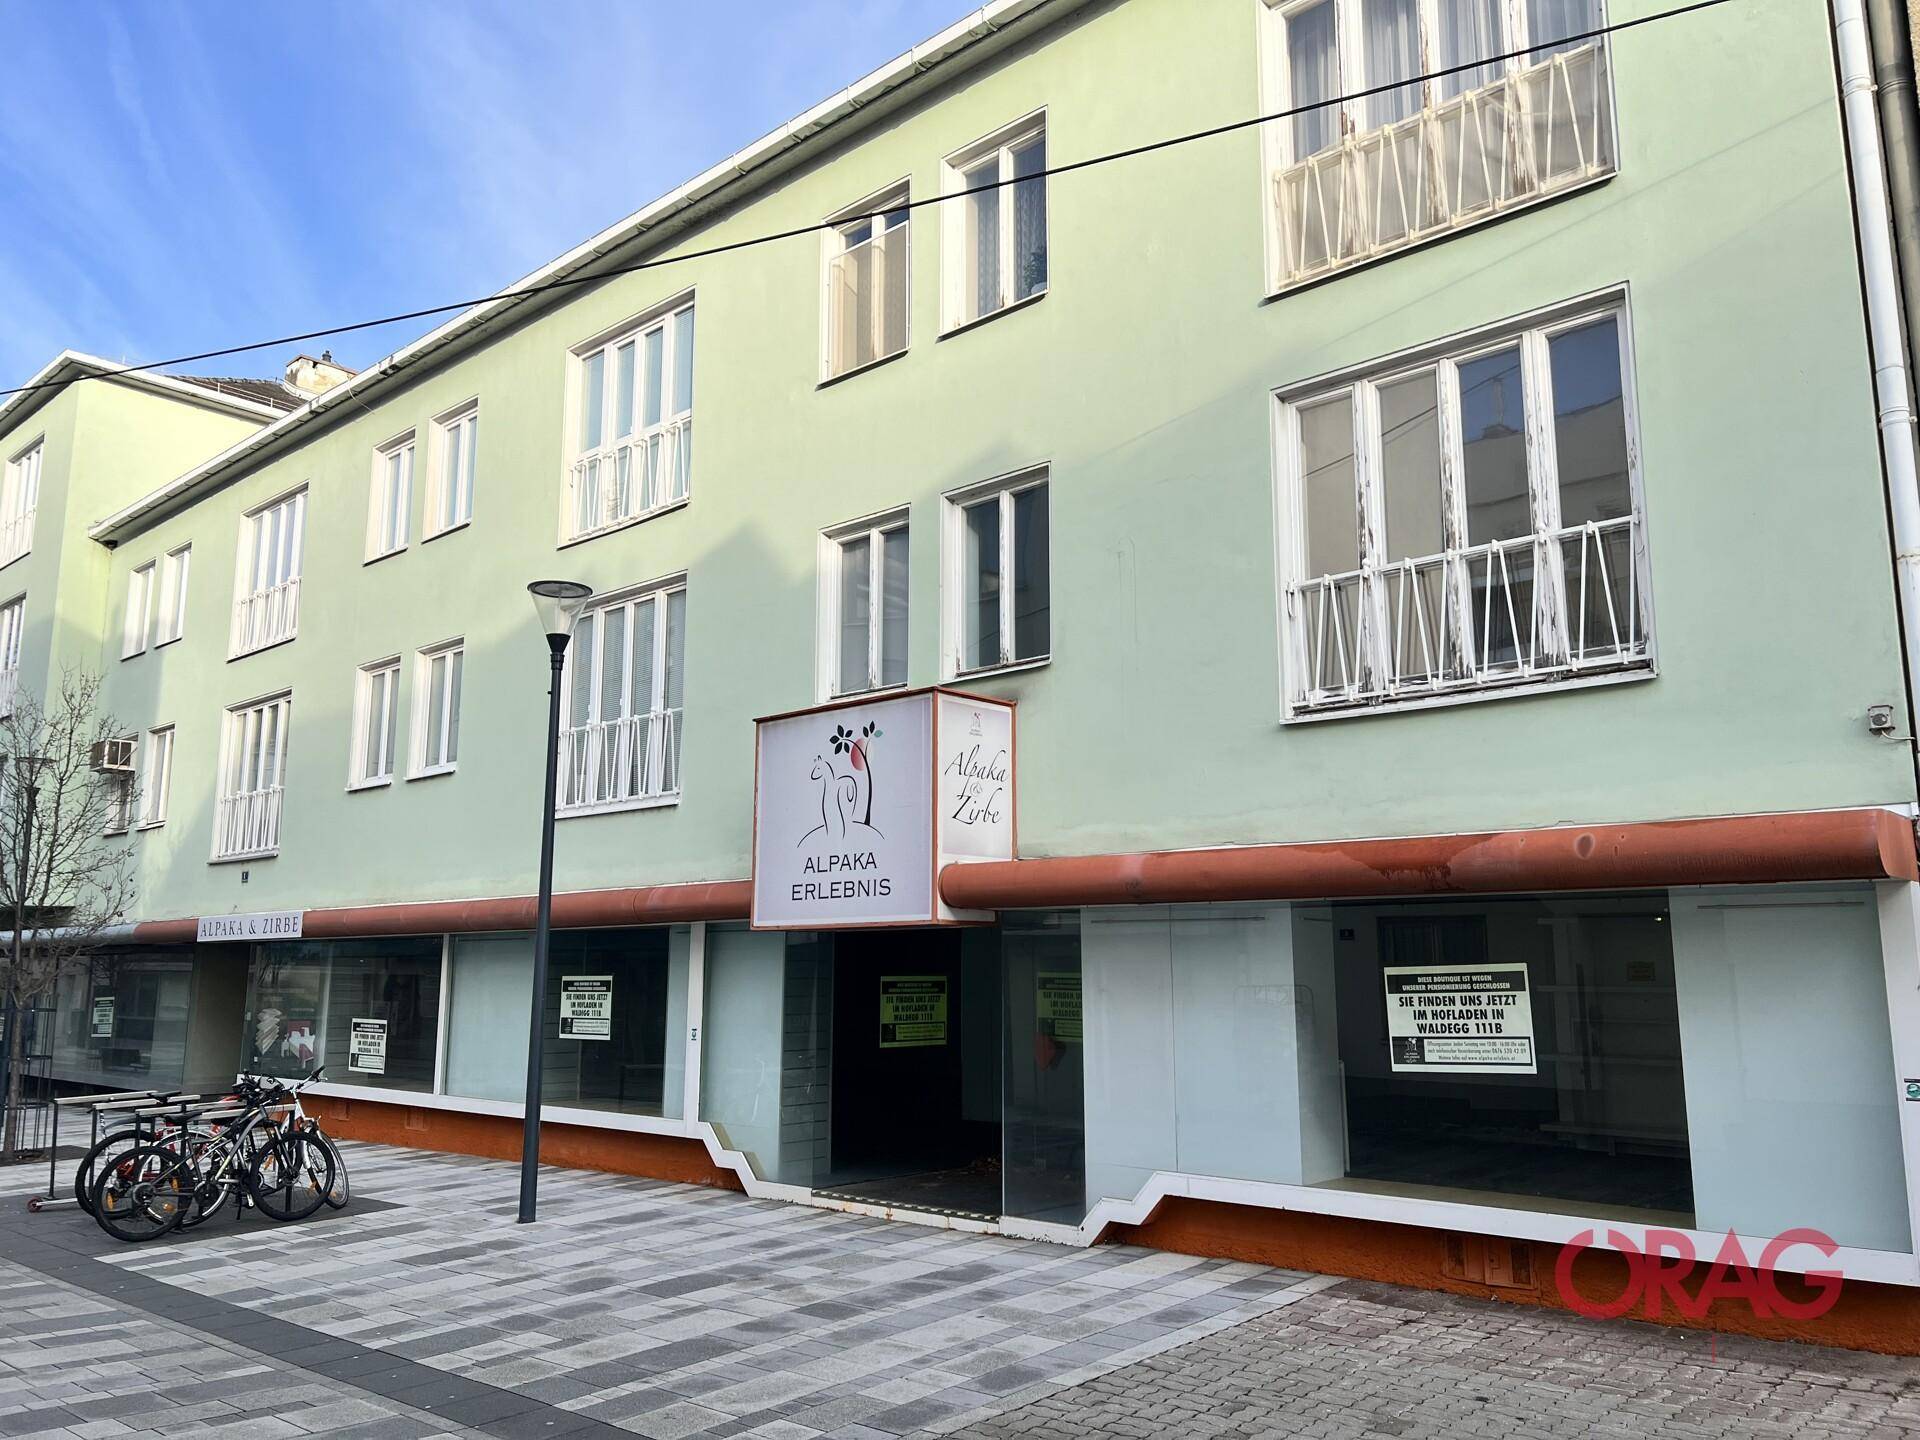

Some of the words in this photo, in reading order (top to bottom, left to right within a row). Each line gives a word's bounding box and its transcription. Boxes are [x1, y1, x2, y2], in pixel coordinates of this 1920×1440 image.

[945, 744, 1007, 800] Alpaka
[952, 787, 1002, 825] Zirbe
[803, 851, 878, 874] ALPAKA
[791, 878, 892, 901] ERLEBNIS
[200, 920, 243, 937] ALPAKA
[248, 919, 257, 935] &
[263, 916, 299, 934] ZIRBE
[1433, 975, 1460, 983] BOUTIQUE
[1399, 996, 1415, 1007] SIE
[1418, 996, 1456, 1007] FINDEN
[1460, 995, 1482, 1006] UNS
[1486, 994, 1517, 1006] JETZT
[1413, 1010, 1428, 1020] IM
[1431, 1009, 1488, 1020] HOFLADEN
[1492, 1009, 1504, 1020] IN
[1417, 1023, 1470, 1034] WALDEGG
[1475, 1023, 1503, 1034] 111B
